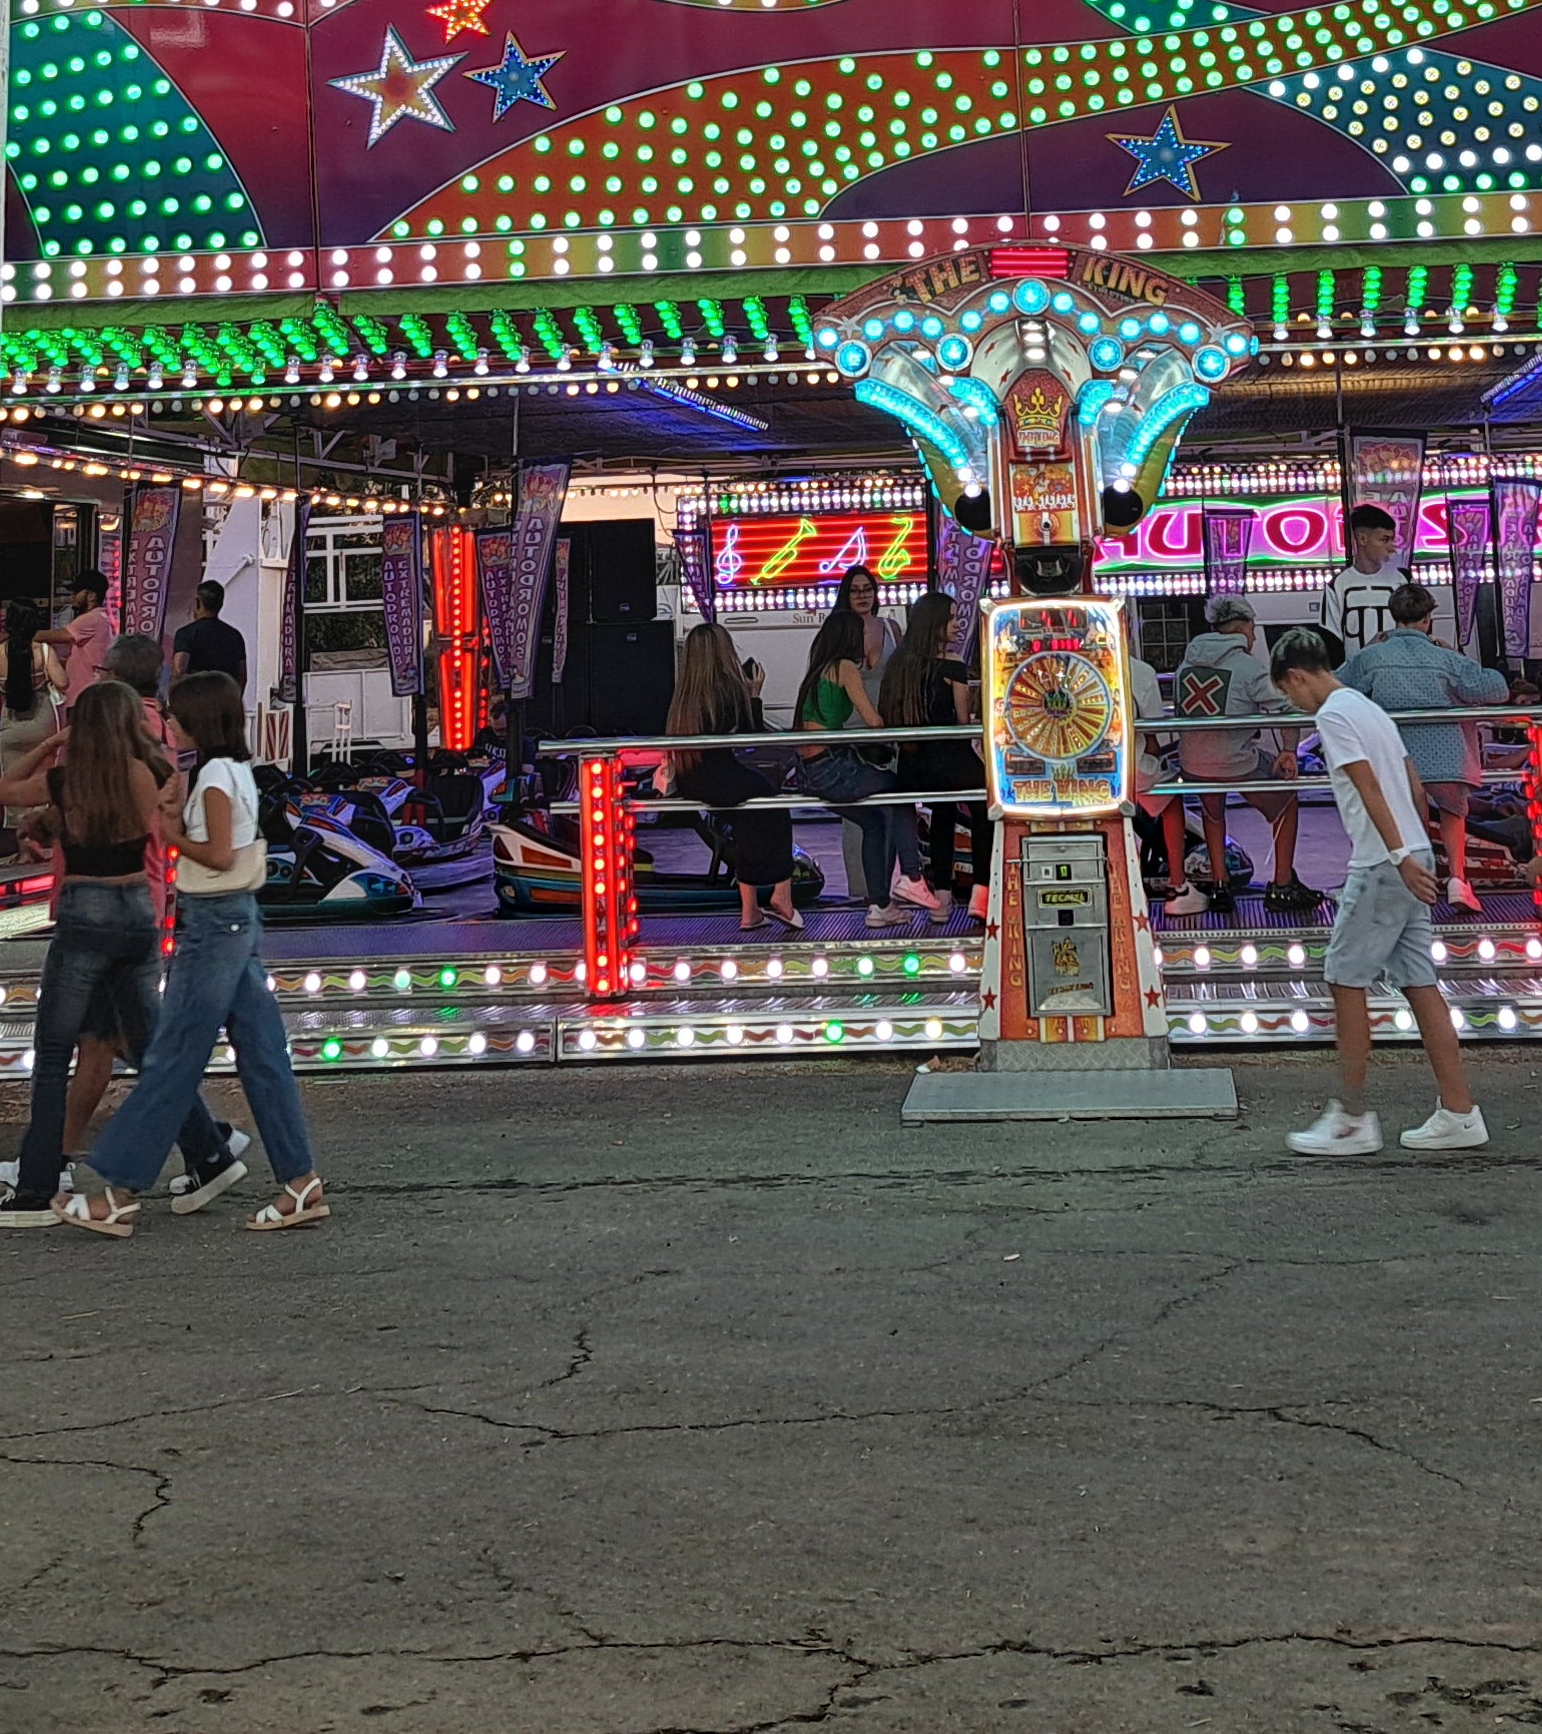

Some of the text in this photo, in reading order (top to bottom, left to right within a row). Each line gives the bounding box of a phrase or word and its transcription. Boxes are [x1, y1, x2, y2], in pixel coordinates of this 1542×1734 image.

[905, 256, 1169, 306] THE KING
[384, 561, 403, 666] AUTODROMOS
[1012, 780, 1052, 802] THE
[1055, 780, 1110, 803] KING
[1008, 923, 1022, 988] KING
